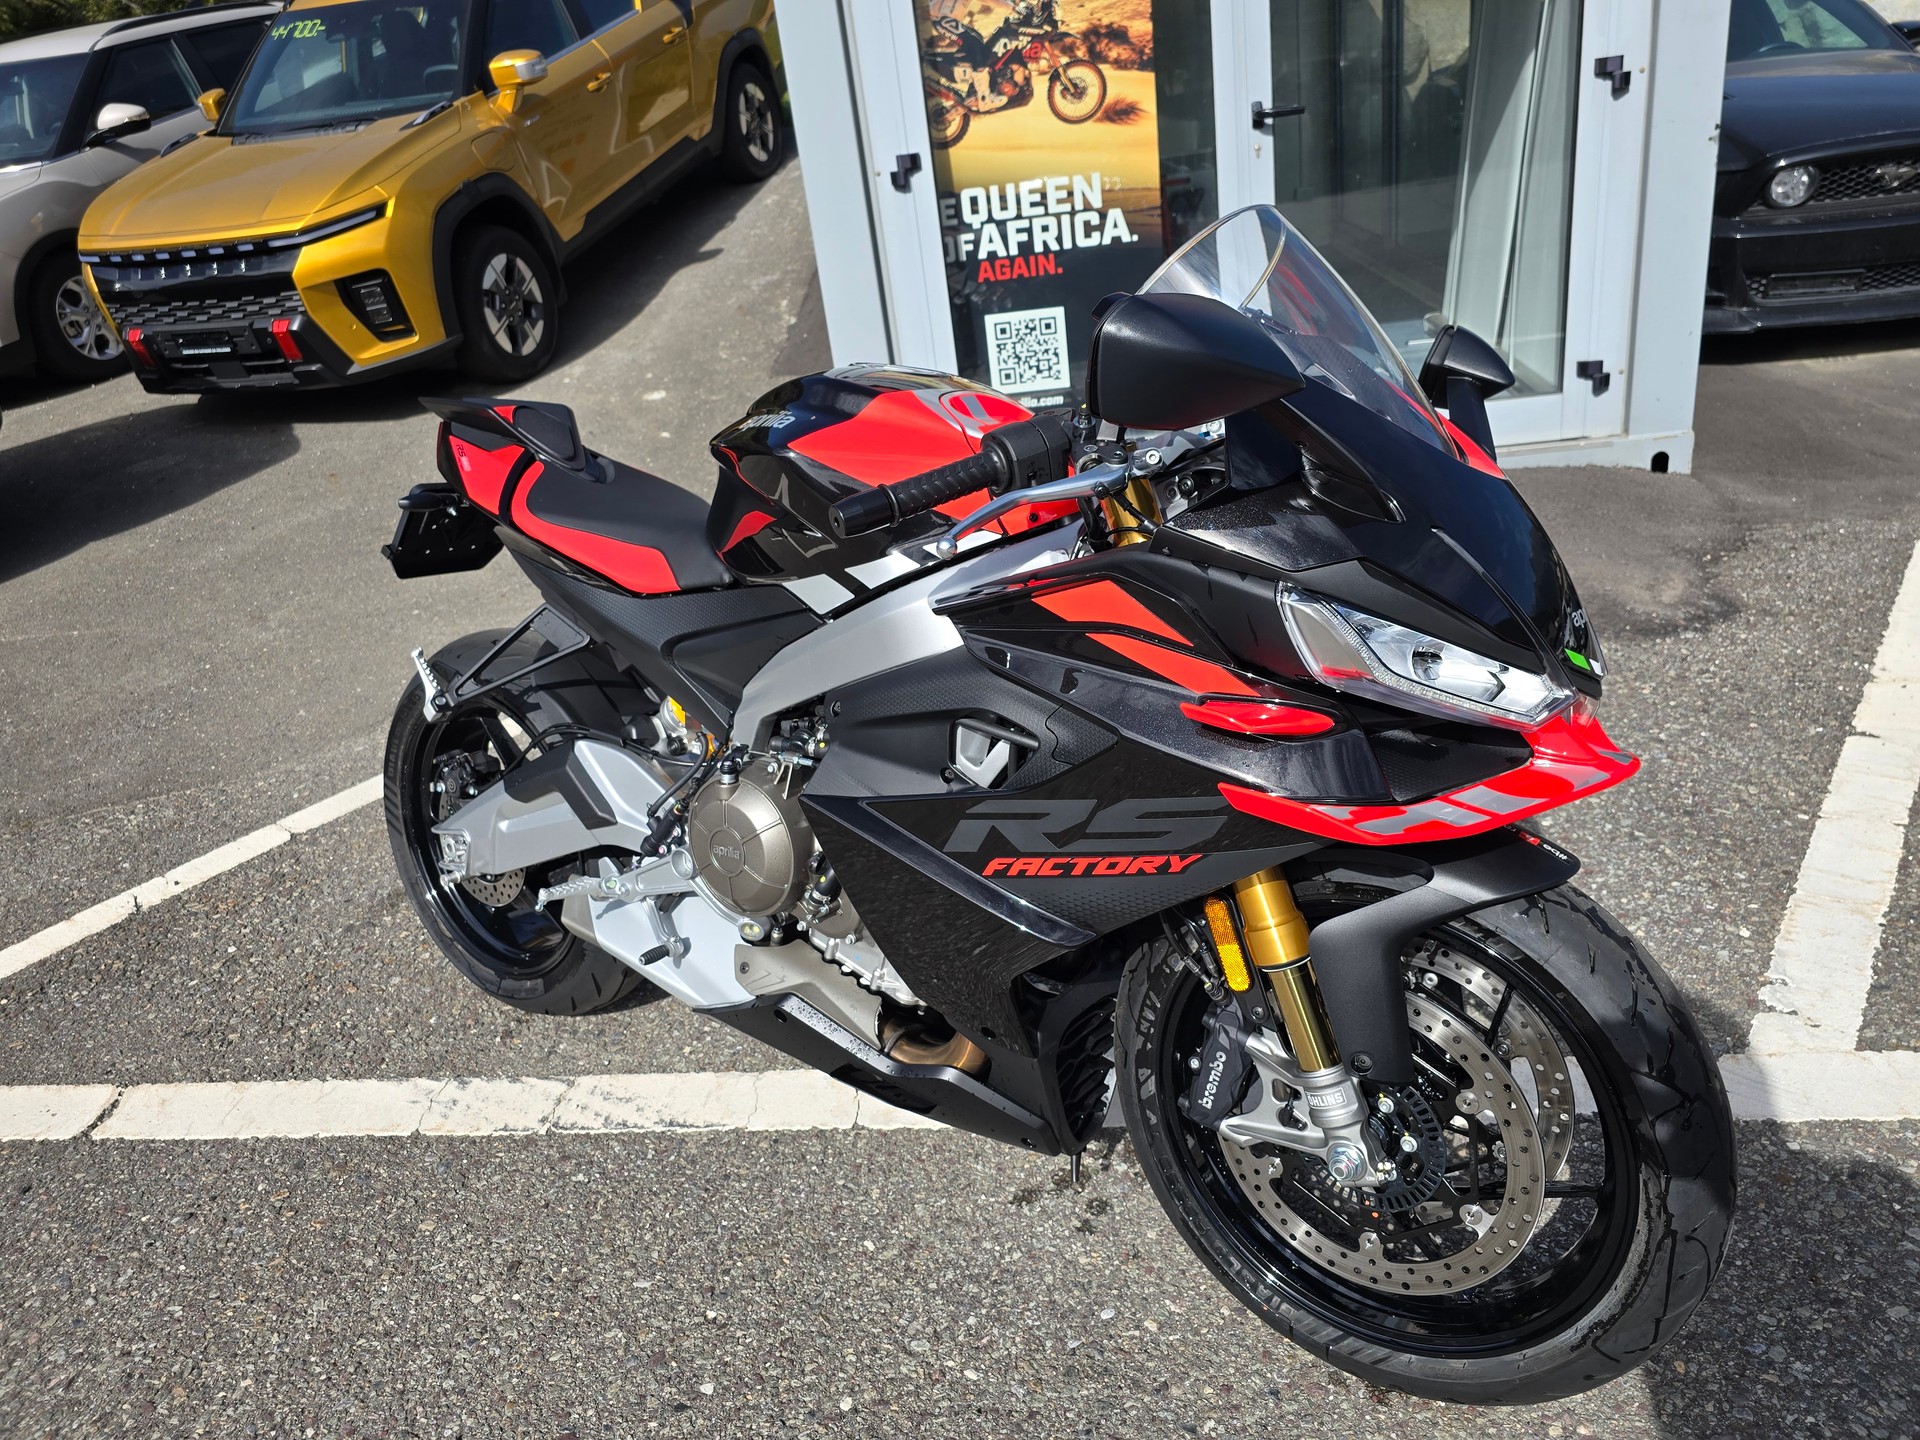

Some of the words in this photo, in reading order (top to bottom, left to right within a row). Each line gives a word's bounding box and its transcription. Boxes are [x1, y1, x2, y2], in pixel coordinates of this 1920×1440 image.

[960, 171, 1104, 230] QUEEN
[977, 207, 1140, 260] AFRICA.
[977, 253, 1064, 283] AGAIN.
[944, 796, 1230, 853] RS
[712, 844, 741, 860] aprilia
[981, 854, 1204, 877] FACTORY
[1197, 1050, 1227, 1111] brembo
